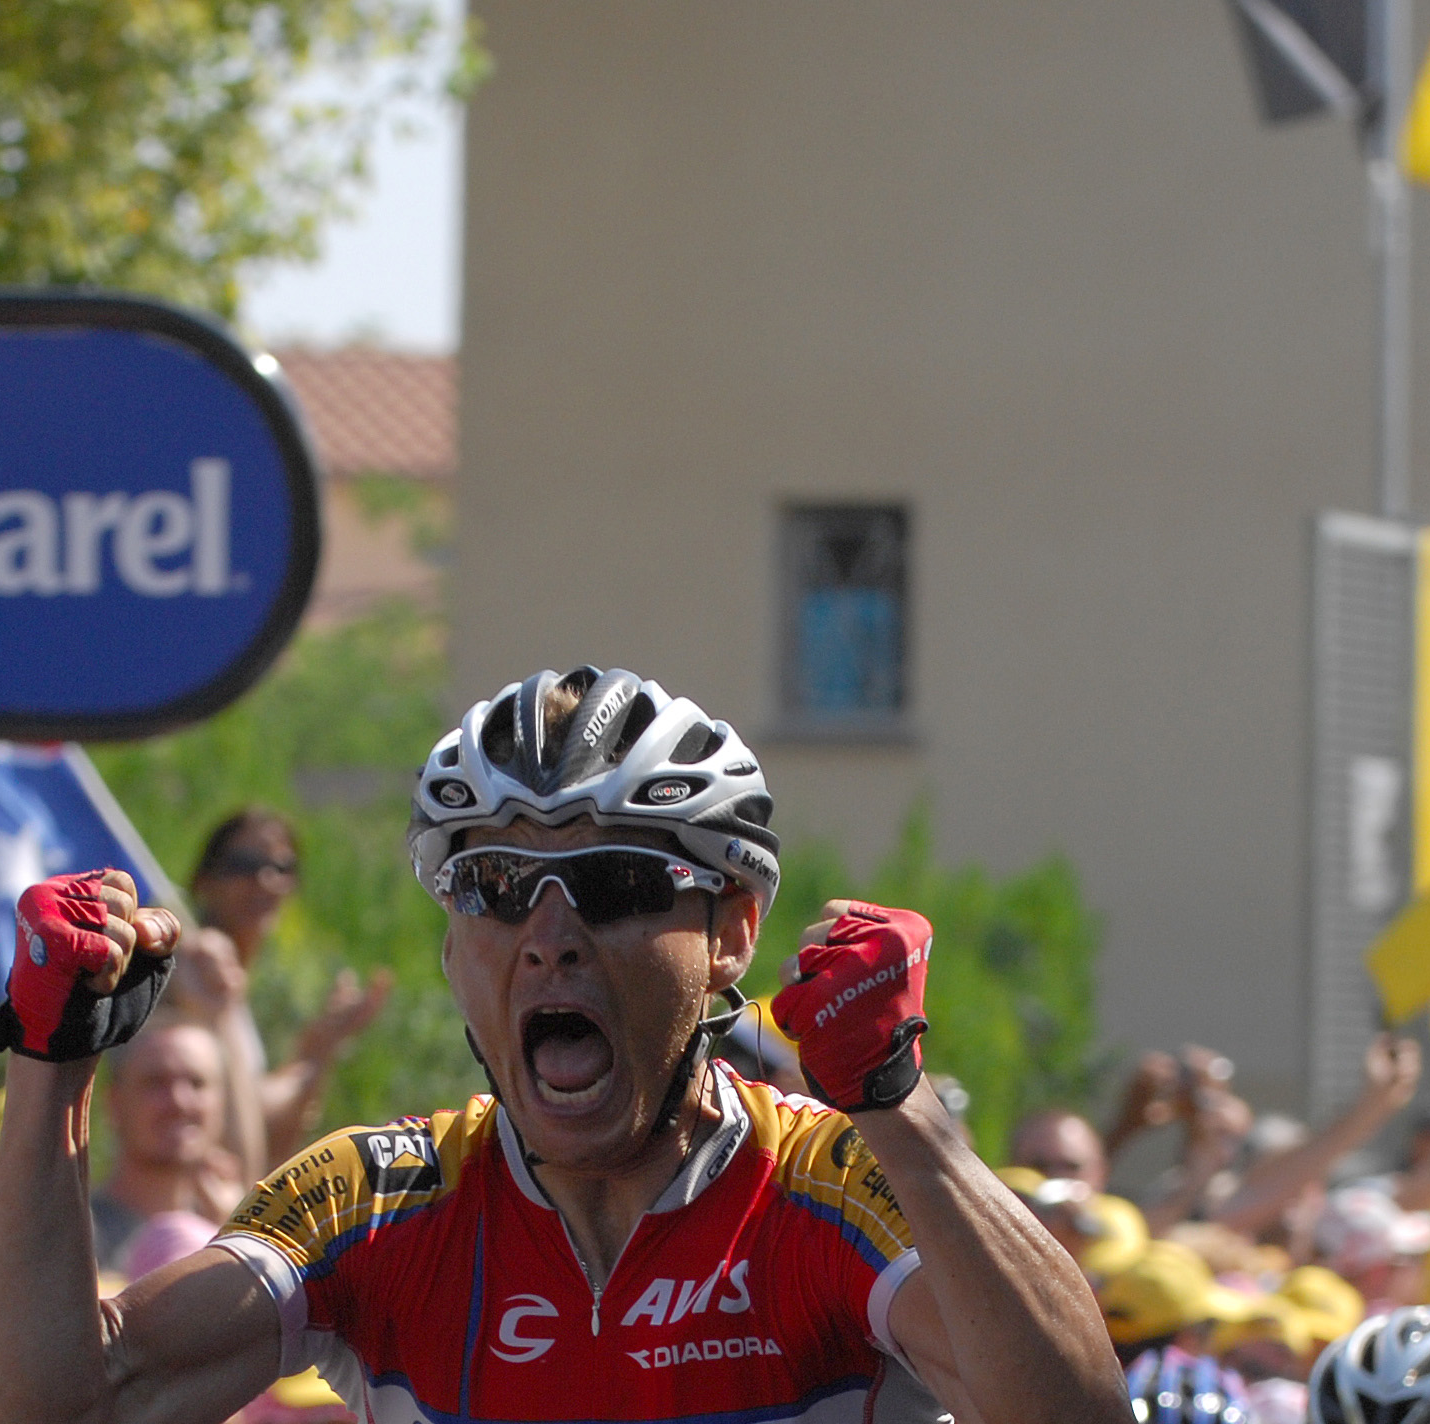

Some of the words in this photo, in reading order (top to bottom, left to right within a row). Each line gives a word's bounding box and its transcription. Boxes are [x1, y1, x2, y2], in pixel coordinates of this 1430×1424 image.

[581, 681, 630, 749] SUOMY
[366, 1133, 438, 1170] CAT
[620, 1258, 753, 1327] AVIS
[653, 1336, 783, 1369] DIADORA
